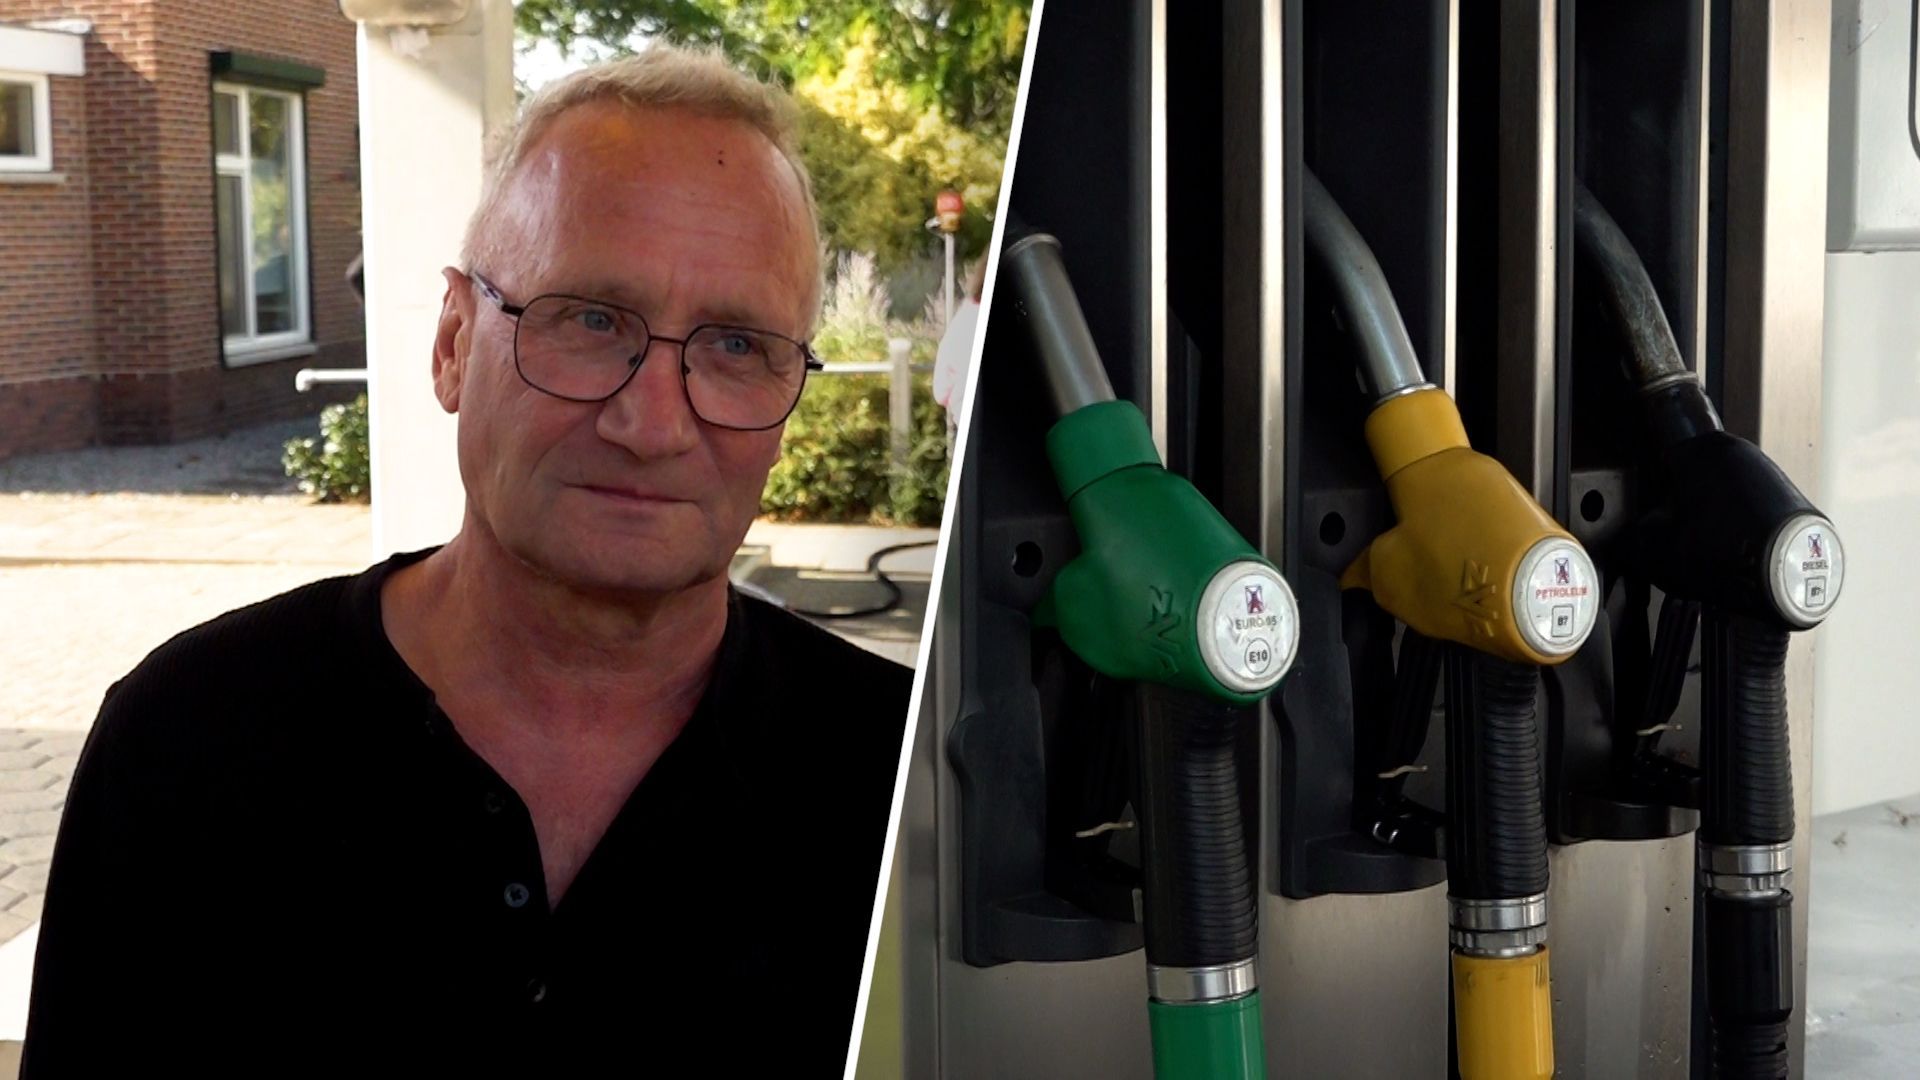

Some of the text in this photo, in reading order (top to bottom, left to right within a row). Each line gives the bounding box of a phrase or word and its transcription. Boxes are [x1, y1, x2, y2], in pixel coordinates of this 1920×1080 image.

[1802, 559, 1829, 572] DIESEL
[1535, 586, 1588, 599] PETROLEUM
[1235, 617, 1265, 630] EURO
[1557, 615, 1568, 626] B7
[1248, 649, 1268, 664] E10
